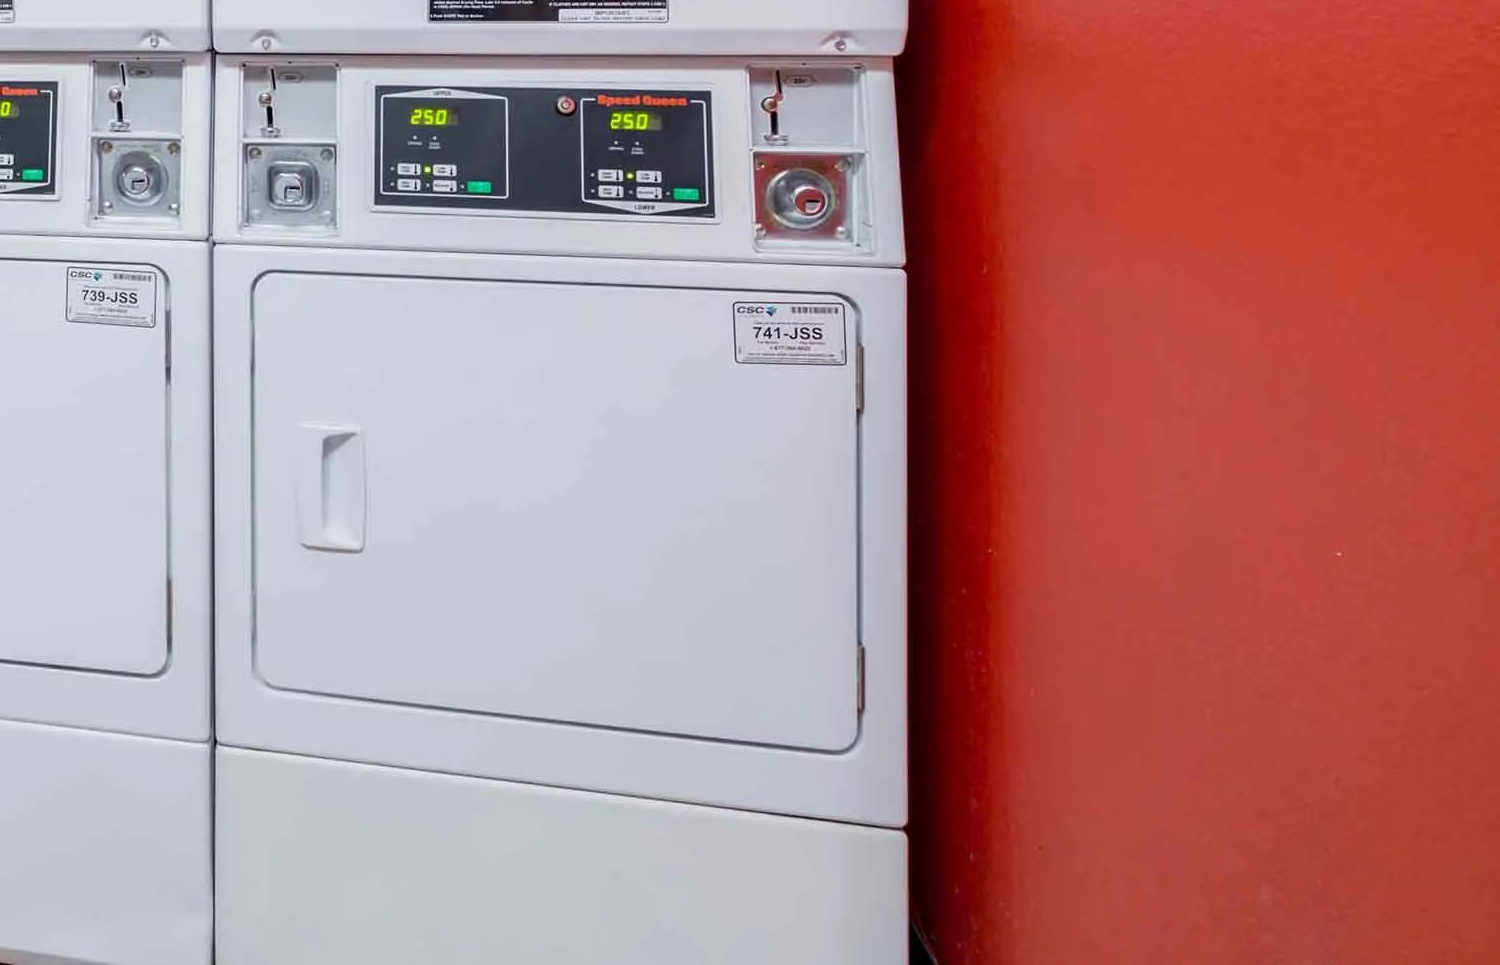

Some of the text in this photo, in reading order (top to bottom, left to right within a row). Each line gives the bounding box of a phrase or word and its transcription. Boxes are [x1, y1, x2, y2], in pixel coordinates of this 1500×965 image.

[2, 86, 38, 96] Queen
[597, 95, 689, 107] Speed Queen
[70, 270, 92, 279] CSC
[82, 289, 138, 305] 739-JSS
[736, 306, 765, 314] CSC
[752, 326, 823, 340] 741-JSS
